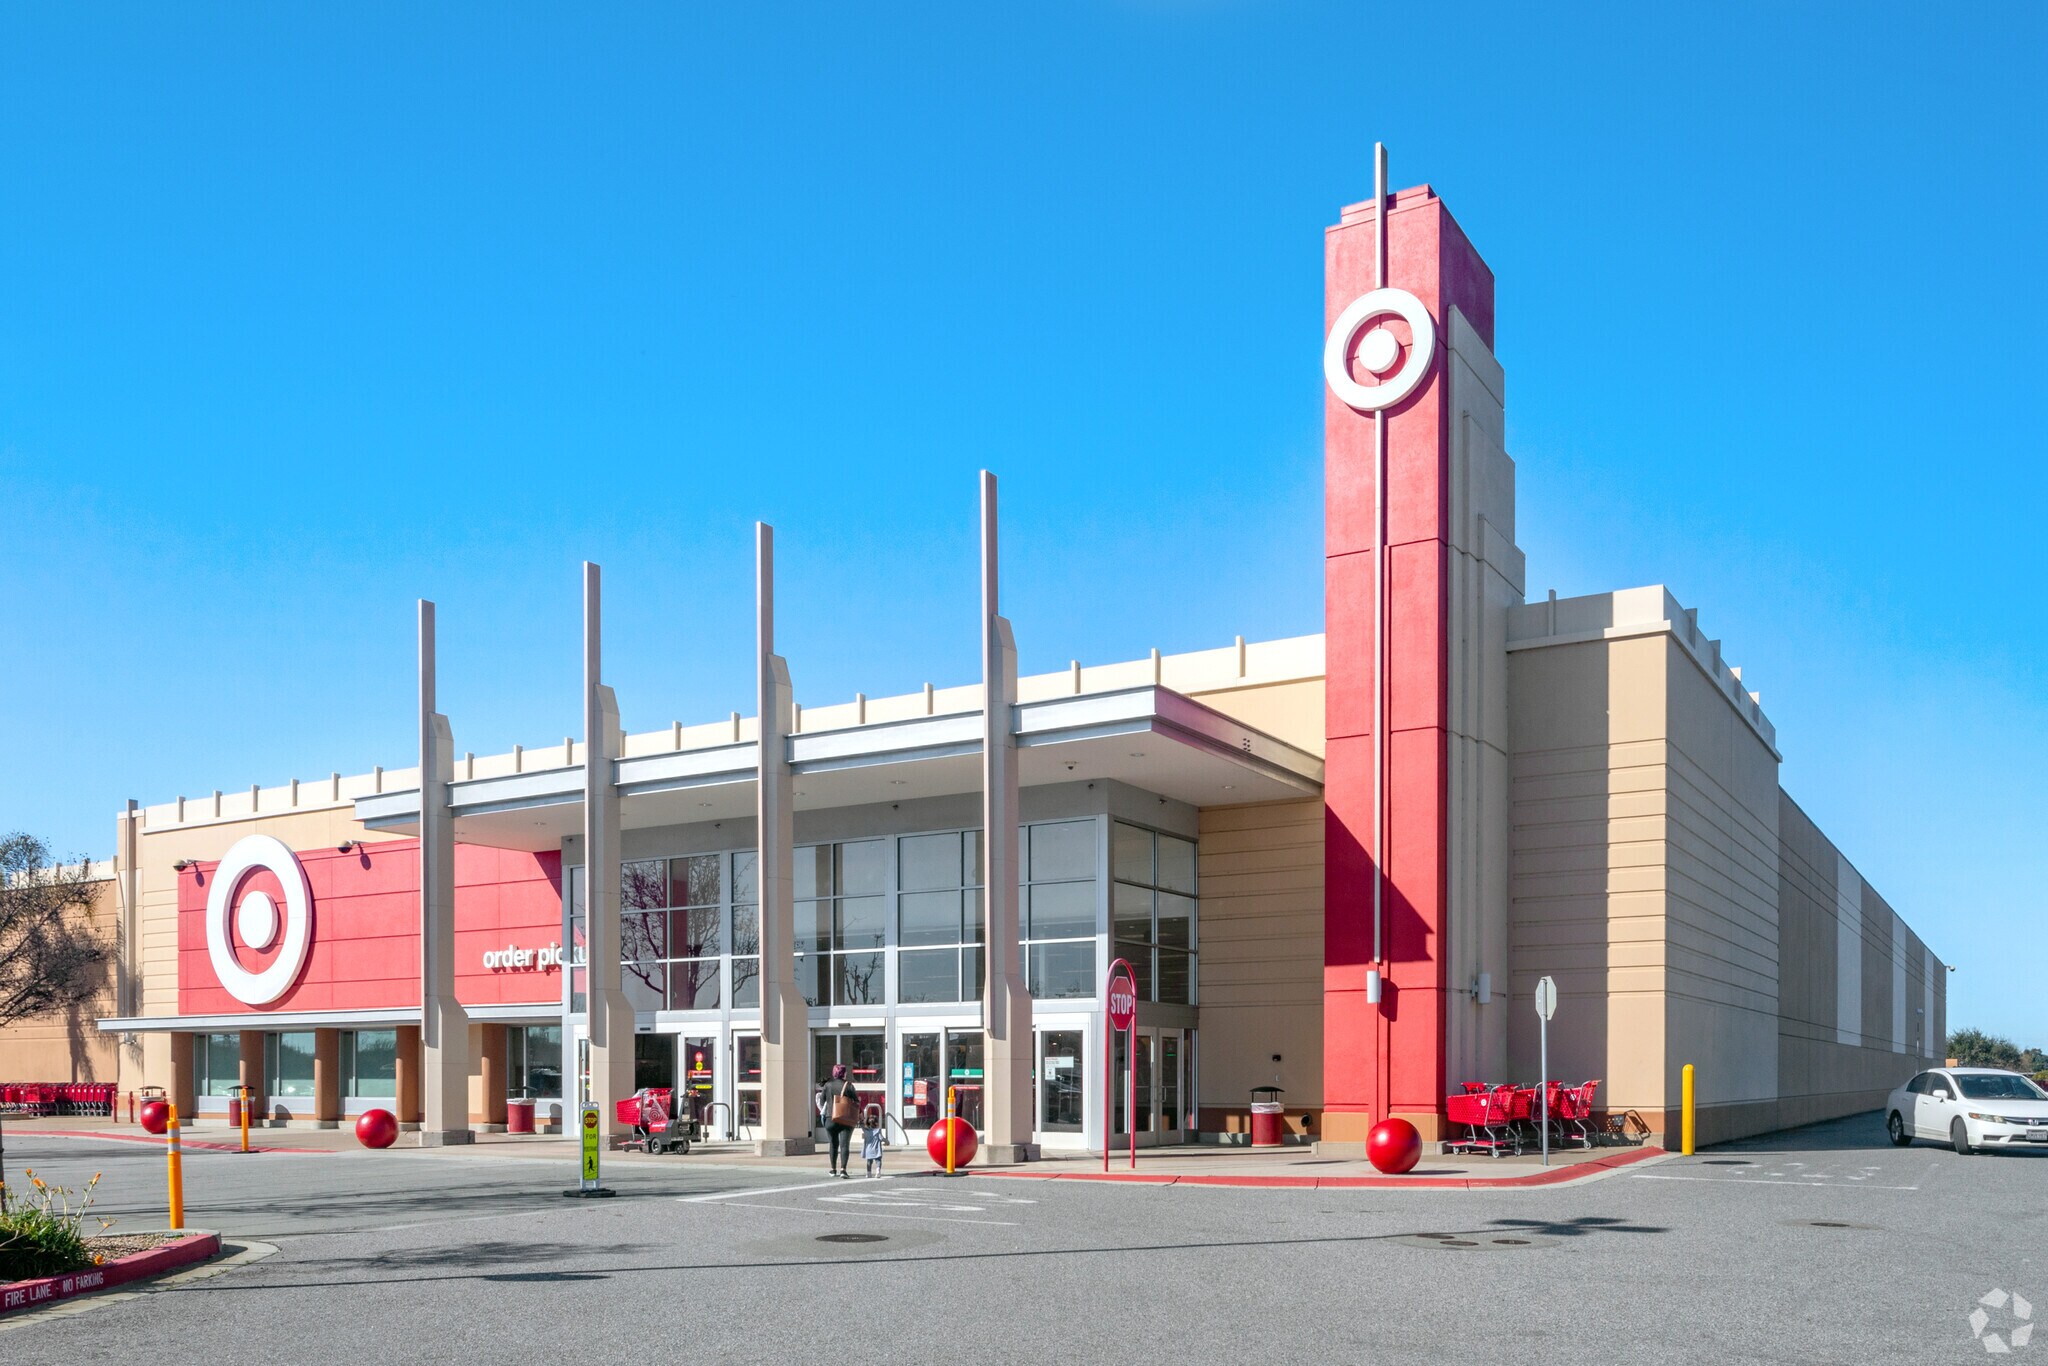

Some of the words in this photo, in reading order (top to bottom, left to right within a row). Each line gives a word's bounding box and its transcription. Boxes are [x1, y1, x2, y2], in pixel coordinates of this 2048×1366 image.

[483, 945, 533, 969] order
[1111, 993, 1132, 1014] STOP
[5, 1290, 26, 1307] FIRE
[29, 1284, 52, 1301] LANE
[62, 1279, 73, 1293] NO
[76, 1271, 104, 1290] PARKING
